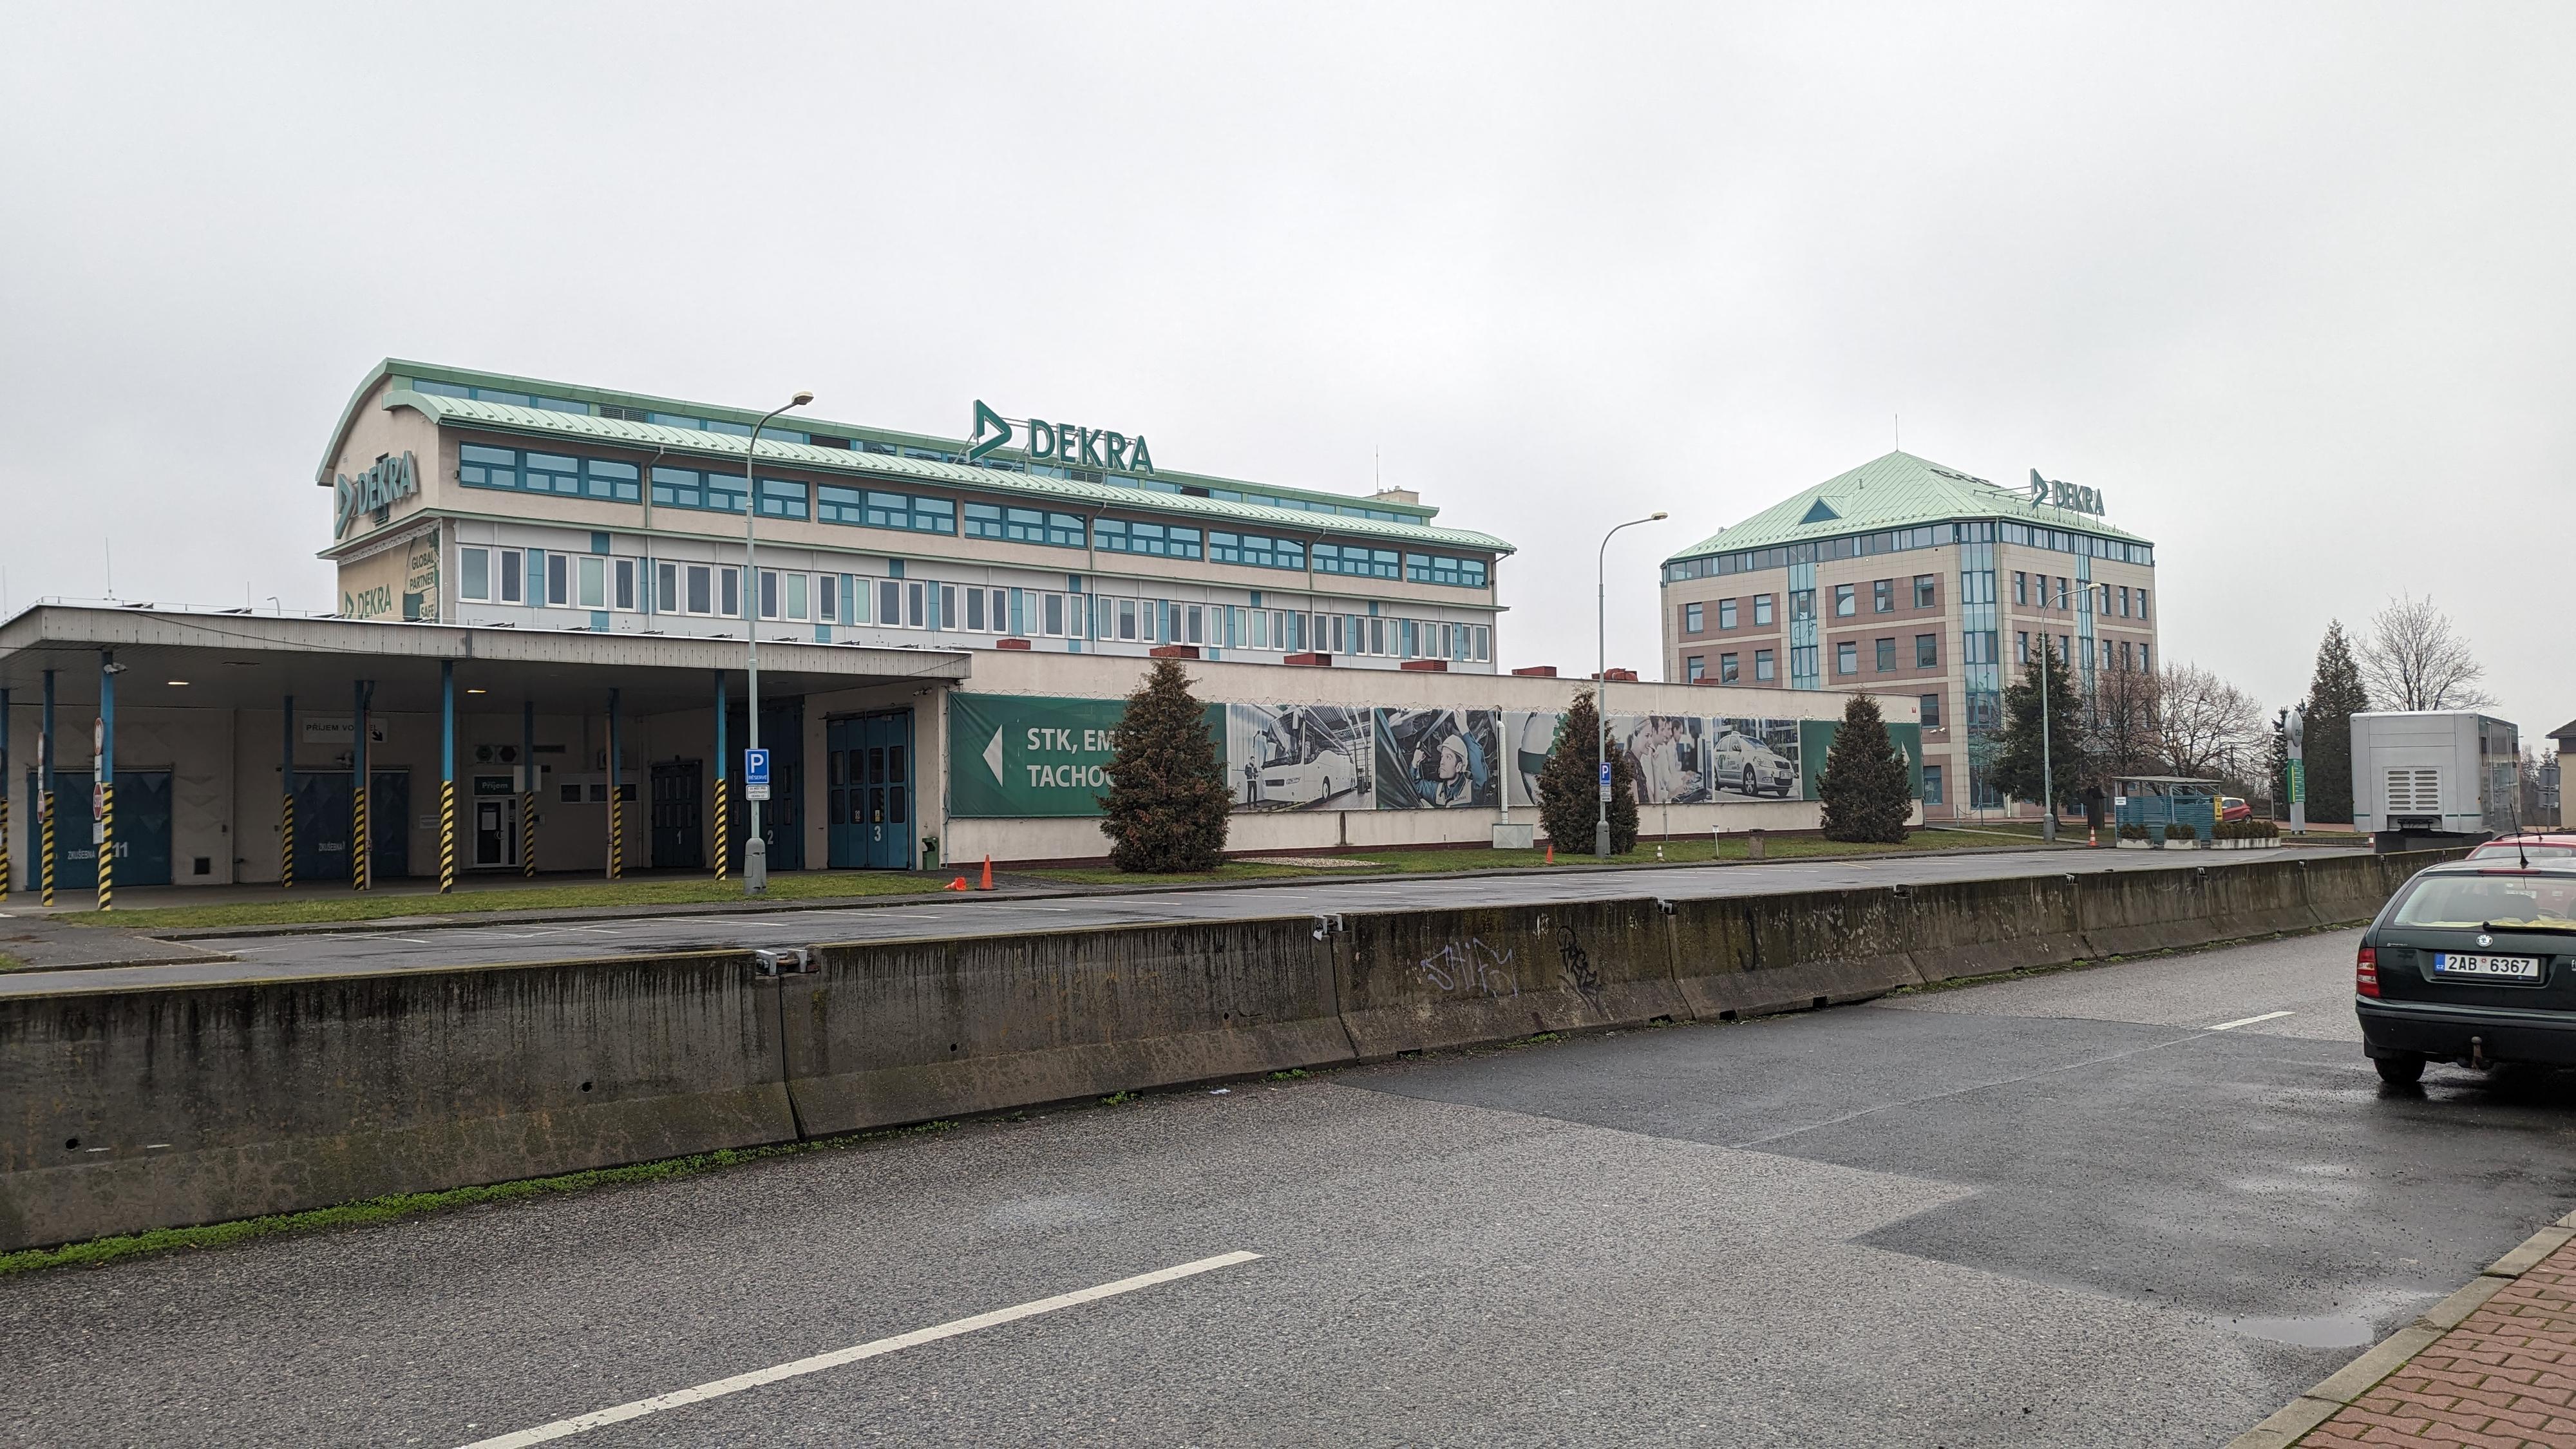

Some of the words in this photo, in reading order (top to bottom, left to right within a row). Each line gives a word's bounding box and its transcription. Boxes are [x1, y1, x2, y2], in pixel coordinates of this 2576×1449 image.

[1028, 419, 1155, 475] DEKRA
[358, 451, 417, 515] DEKRA
[2052, 480, 2105, 516] DEKRA
[412, 551, 434, 570] GLOBAL
[410, 571, 434, 591] PARTNER
[358, 583, 392, 619] DEKRA
[421, 604, 434, 617] SAFE
[1027, 728, 1077, 754] STK,
[751, 754, 764, 773] P
[1602, 765, 1609, 779] P
[677, 830, 681, 845] 1
[767, 829, 773, 845] 2
[874, 825, 881, 842] 3
[2448, 956, 2477, 971] 2AB
[2490, 958, 2530, 974] 6367
